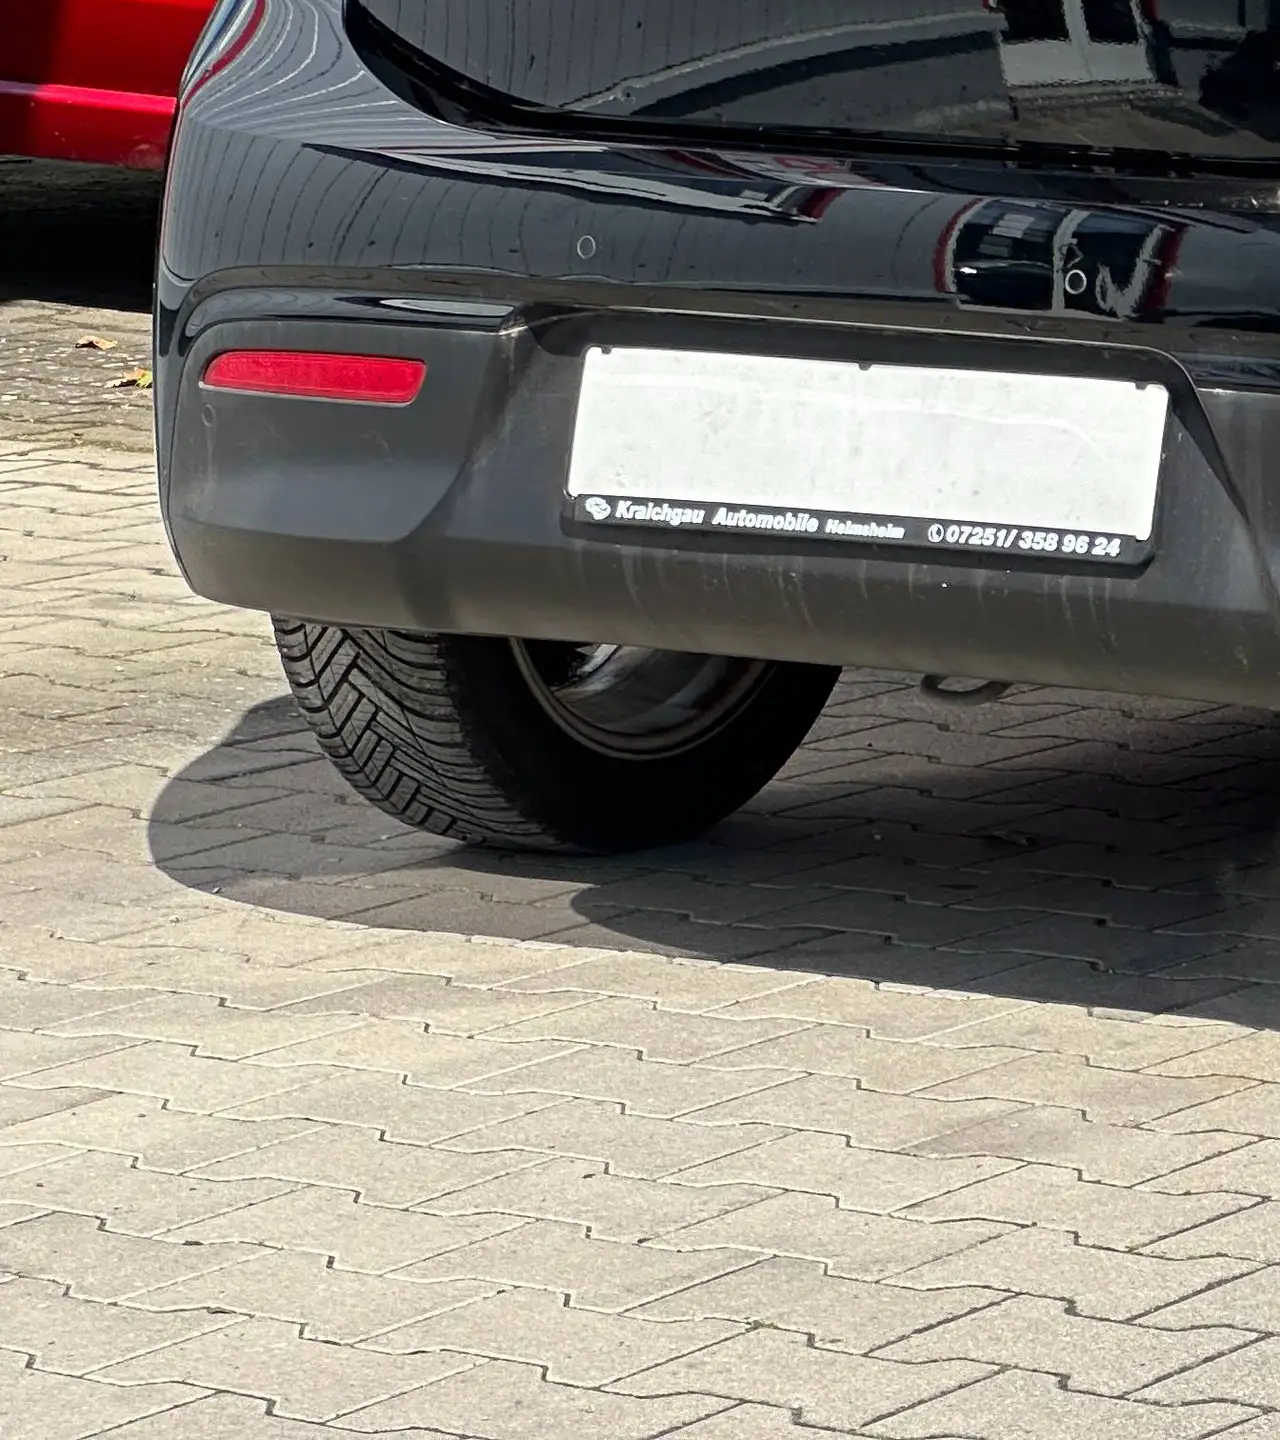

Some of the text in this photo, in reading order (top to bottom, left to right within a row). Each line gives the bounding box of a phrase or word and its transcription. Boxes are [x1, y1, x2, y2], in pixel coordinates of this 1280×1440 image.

[615, 500, 705, 526] Kraichgau
[712, 507, 819, 533] Automobile
[945, 524, 1018, 549] 07251/
[1018, 530, 1058, 552] 358
[1061, 534, 1089, 554] 96
[1091, 537, 1121, 558] 24
